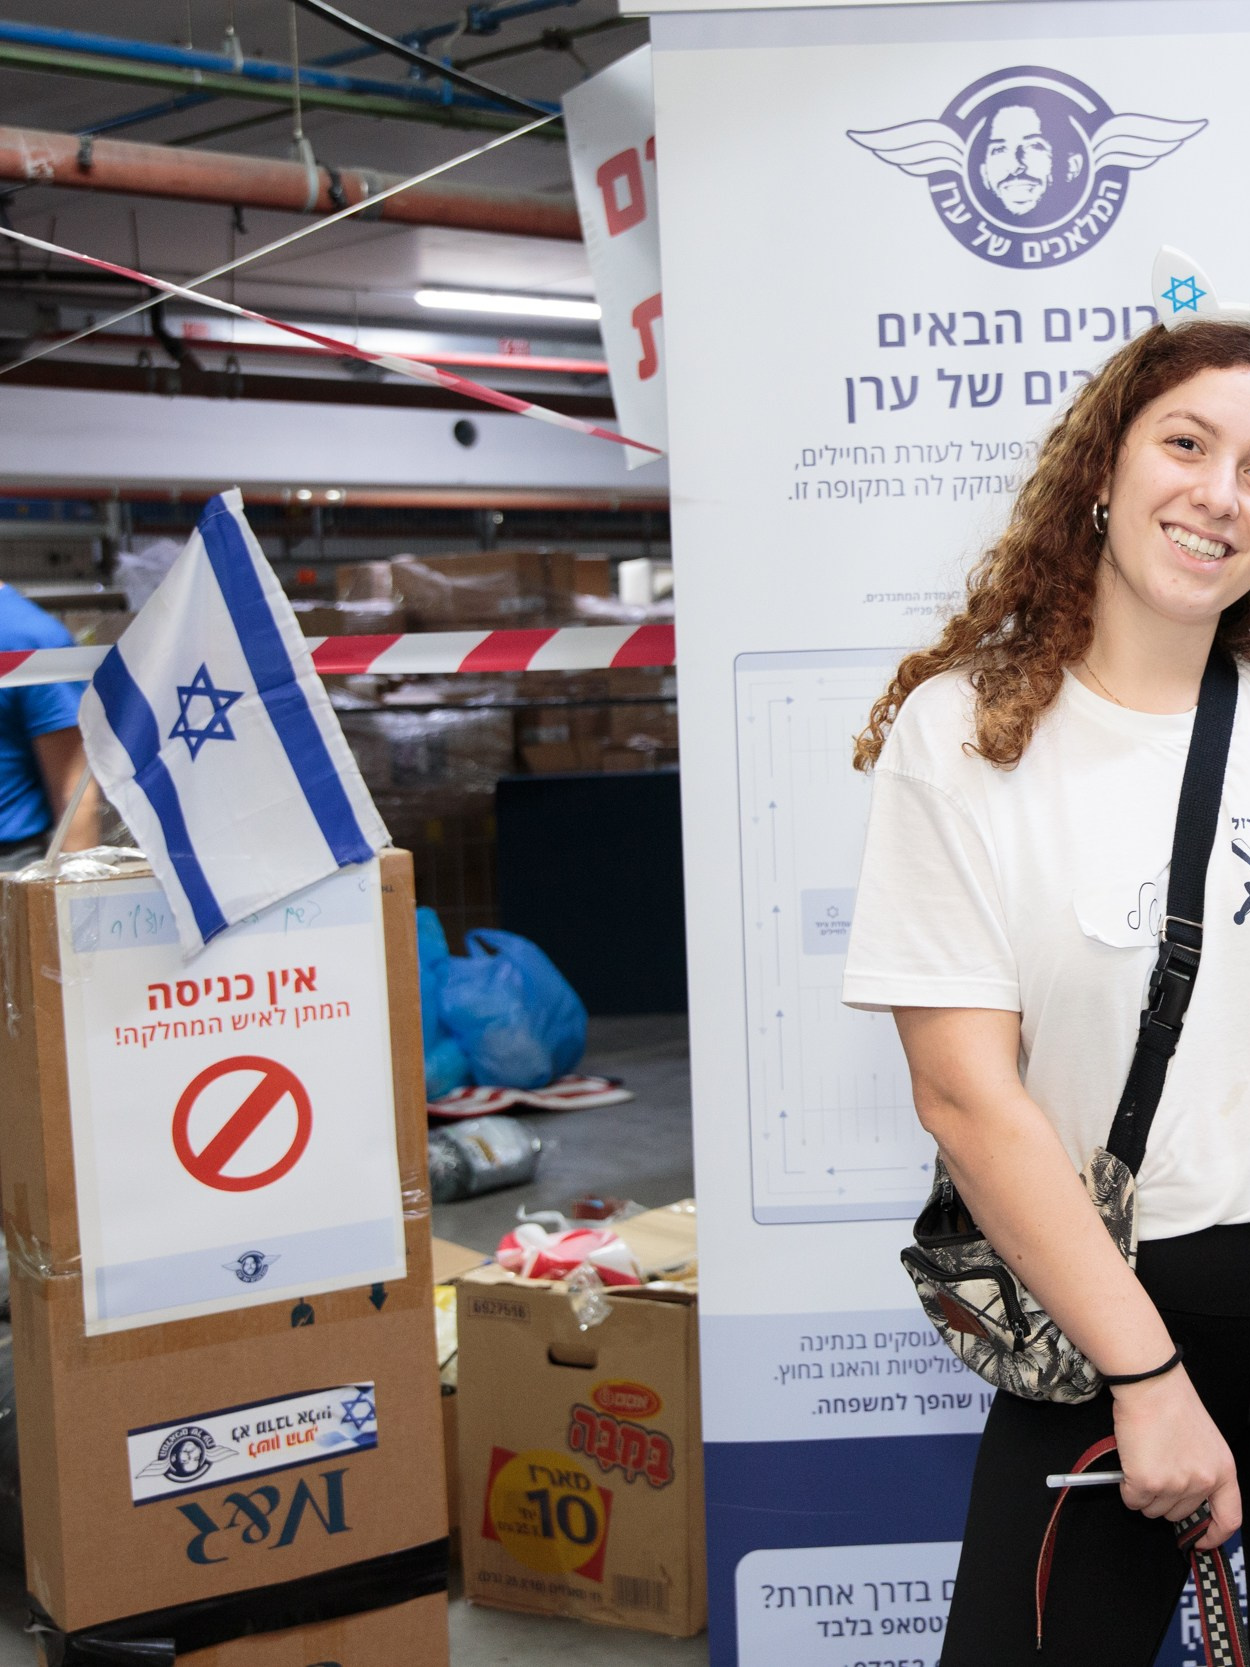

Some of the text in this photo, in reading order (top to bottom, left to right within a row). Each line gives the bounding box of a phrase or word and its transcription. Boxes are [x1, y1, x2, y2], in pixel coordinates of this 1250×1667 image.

[596, 135, 656, 237] ם
[930, 180, 1122, 262] המלאכים של ערן
[878, 305, 1159, 348] רוכים הבאים
[845, 367, 1096, 424] ים של ערן
[794, 440, 1038, 471] הפועל לעזרת החיילים,
[788, 474, 1022, 504] שנזקק לה בתקופה זו.
[148, 966, 317, 1010] אין כניסה
[115, 1001, 350, 1048] המתן לאיש המחלקה!
[800, 1331, 945, 1352] עוסקים בנתינה
[774, 1355, 970, 1385] פוליטיות והאגו בחוץ.
[811, 1393, 908, 1415] למשפחה.
[914, 1393, 973, 1415] שהפך
[231, 1426, 250, 1443] לא
[256, 1416, 293, 1435] מדבר
[248, 1433, 281, 1458] לשון
[528, 1464, 591, 1491] מארז
[176, 1467, 353, 1566] M&R
[526, 1488, 598, 1546] 10
[761, 1584, 854, 1609] אחרת?
[864, 1581, 932, 1611] בדרך
[817, 1615, 949, 1637] טסאפ בלבד
